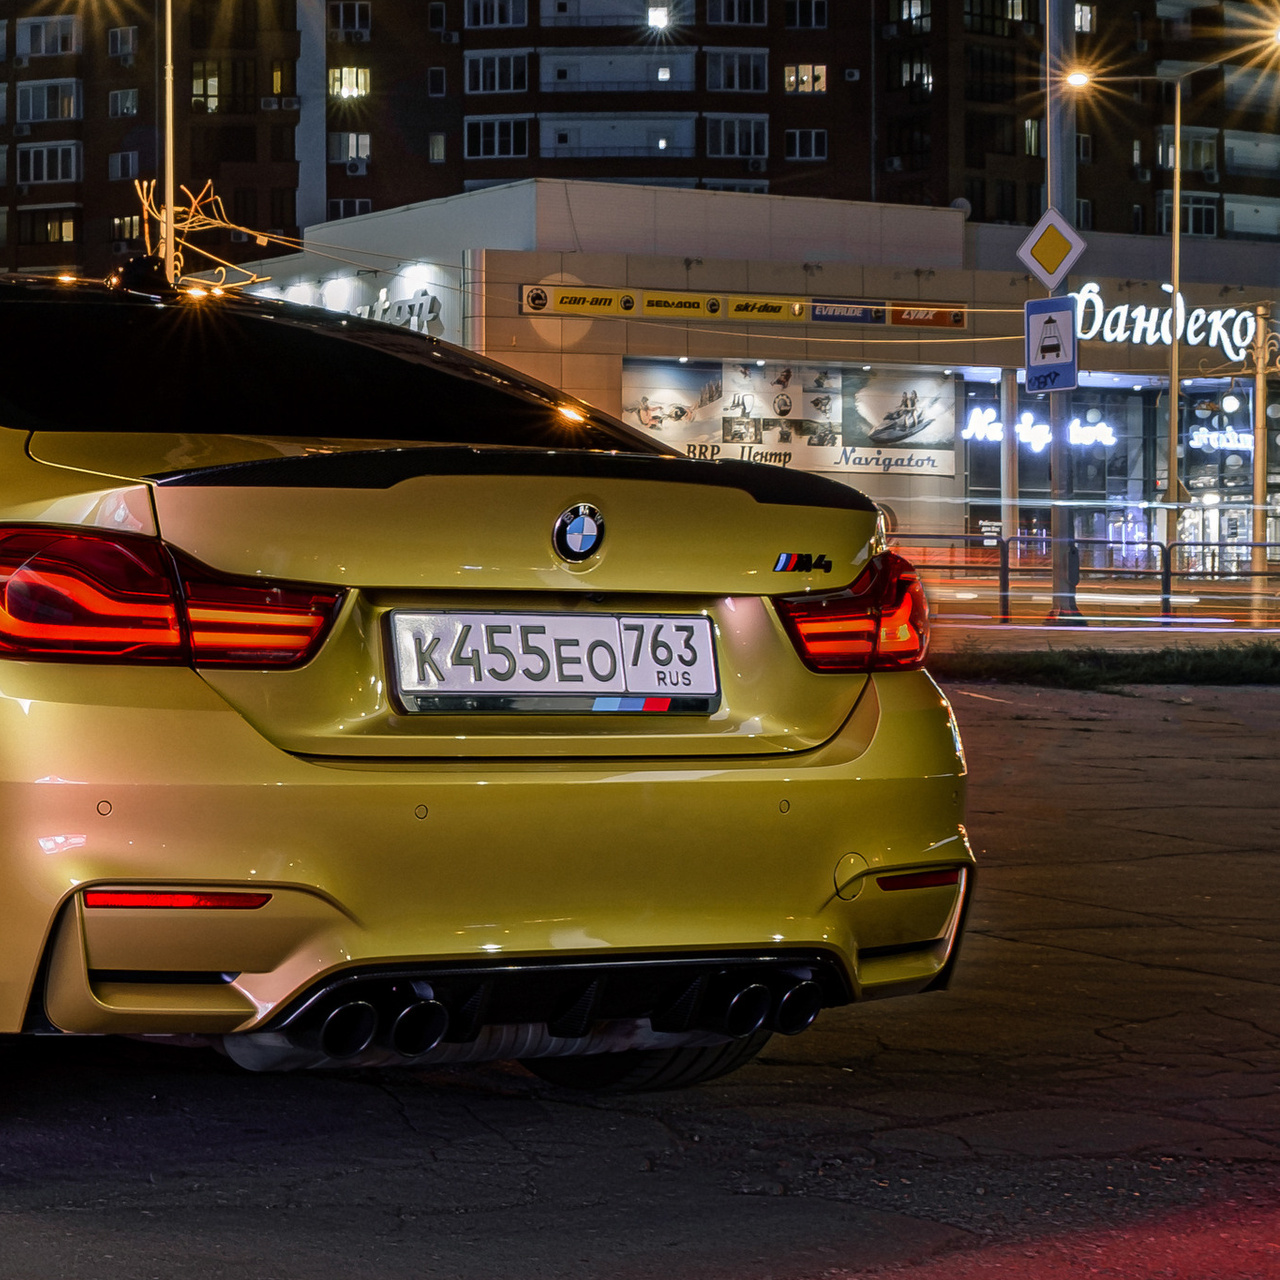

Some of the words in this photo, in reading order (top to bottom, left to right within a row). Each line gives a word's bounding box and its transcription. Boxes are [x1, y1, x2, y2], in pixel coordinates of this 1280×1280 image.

[686, 443, 721, 460] BRP
[833, 446, 939, 472] Navigator
[561, 505, 603, 525] BMW
[623, 623, 698, 667] 763
[656, 670, 693, 687] RUS
